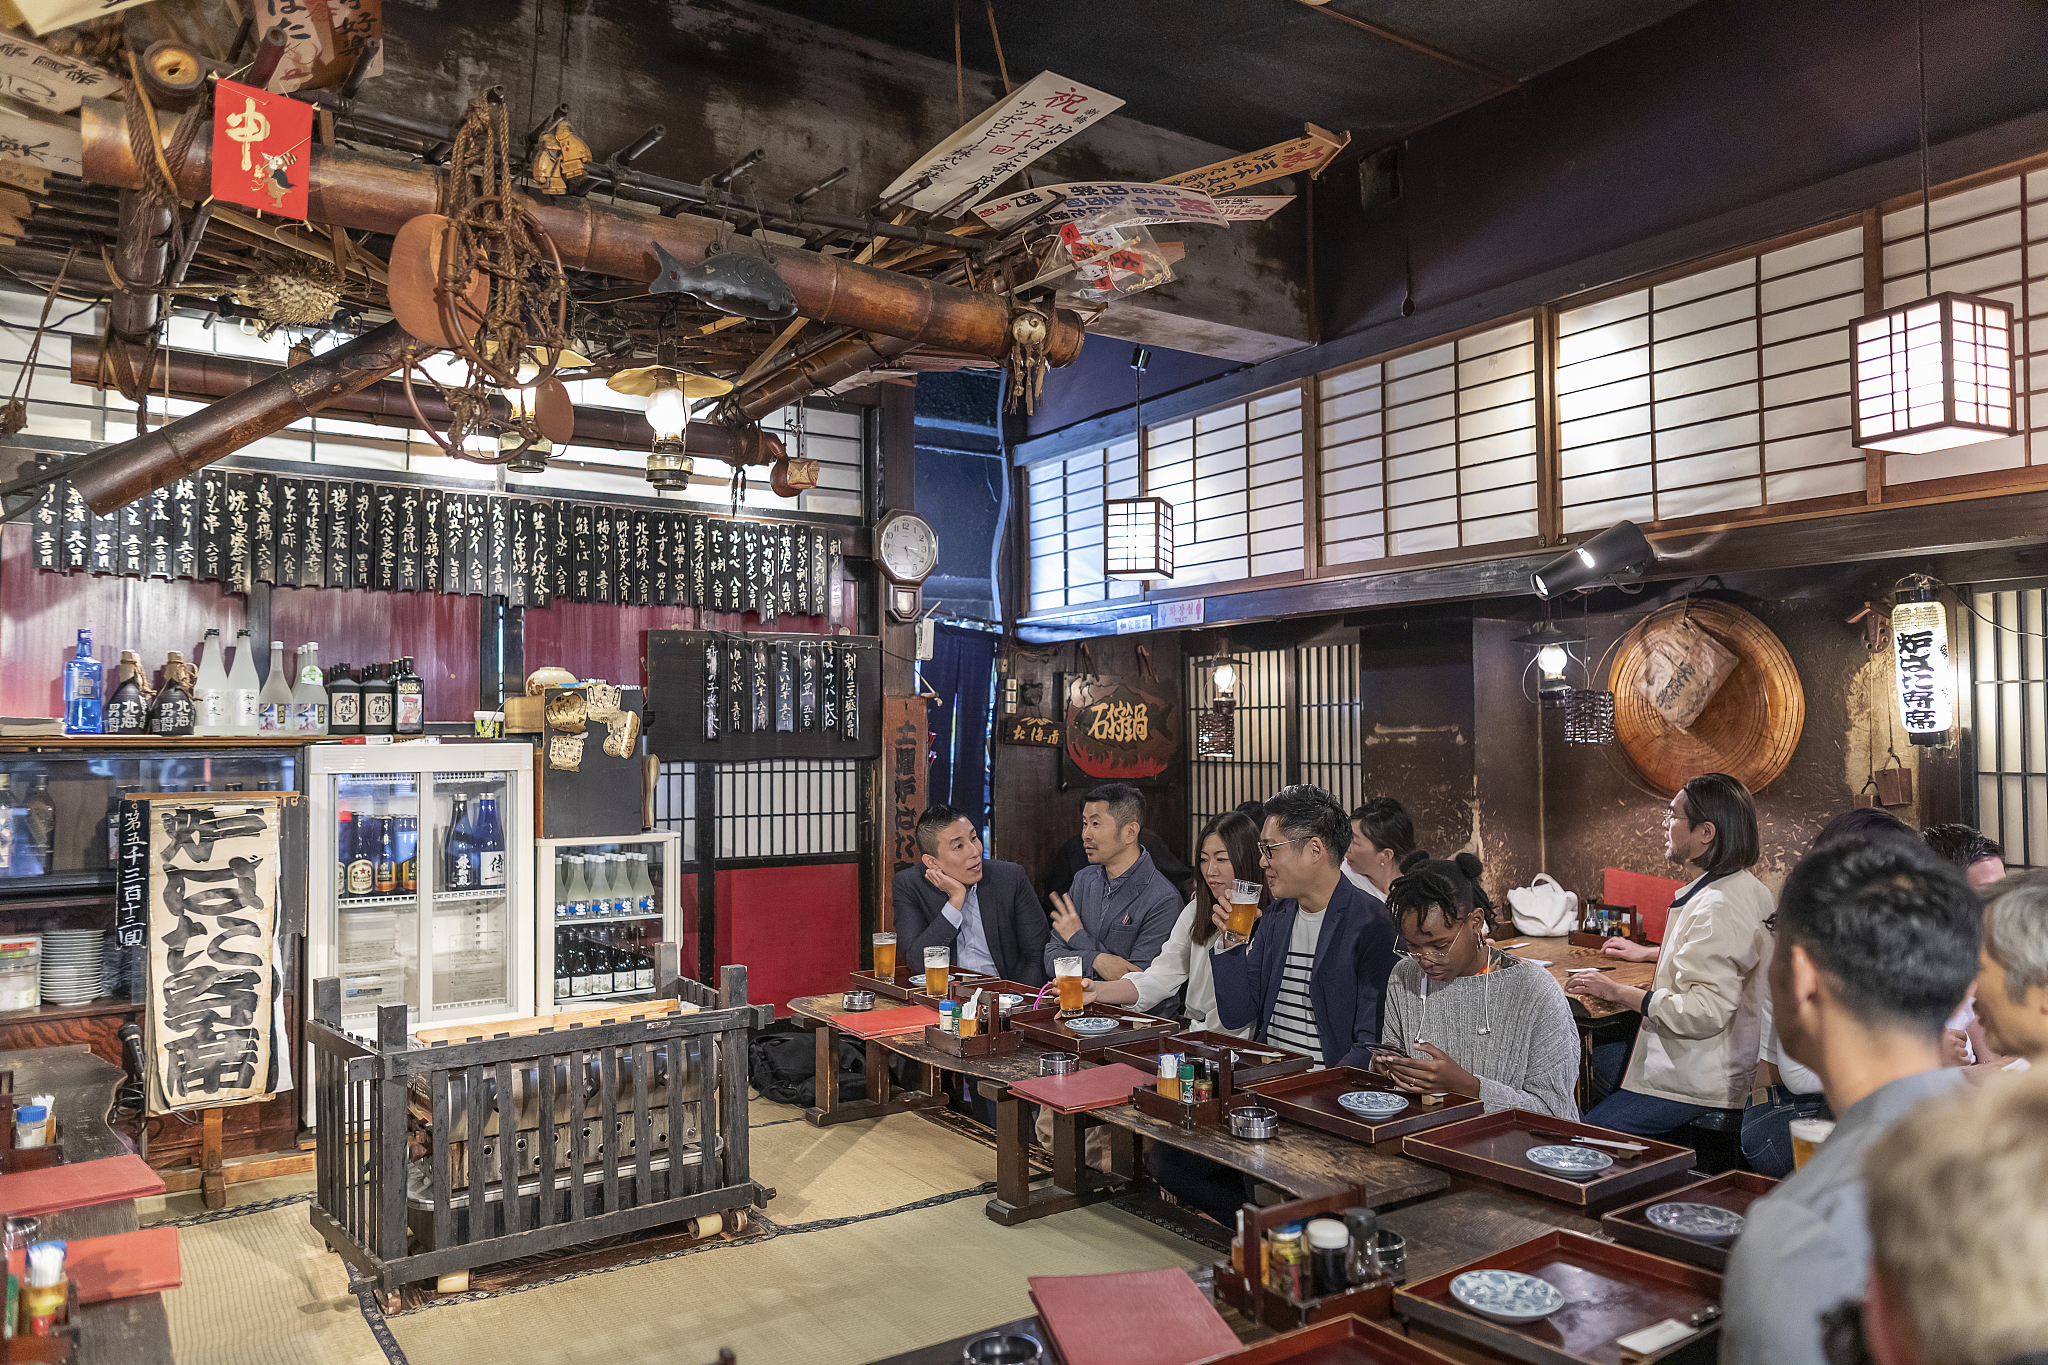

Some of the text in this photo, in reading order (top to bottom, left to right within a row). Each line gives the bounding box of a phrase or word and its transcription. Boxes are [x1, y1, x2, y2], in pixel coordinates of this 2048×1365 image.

[224, 98, 271, 171] 申
[989, 87, 1089, 156] 祝 五千回
[202, 480, 222, 535] かも串
[446, 502, 464, 554] 帆立バター
[468, 503, 484, 554] いかバター
[574, 516, 591, 562] 鮭とば
[655, 520, 669, 567] もずく
[634, 522, 650, 572] 北海珍味
[728, 530, 742, 568] ルイベ
[801, 654, 813, 696] そら豆
[108, 703, 121, 733] 男爵
[120, 700, 139, 729] 北海
[160, 702, 174, 732] 男爵
[174, 700, 191, 727] 北海
[1088, 700, 1149, 743] 石狩鍋
[1013, 725, 1060, 745] 北海道
[490, 854, 504, 874] 侍
[556, 904, 567, 917] 生
[575, 902, 587, 916] 生
[599, 901, 610, 914] 生
[622, 900, 632, 912] 生
[646, 898, 655, 910] 生
